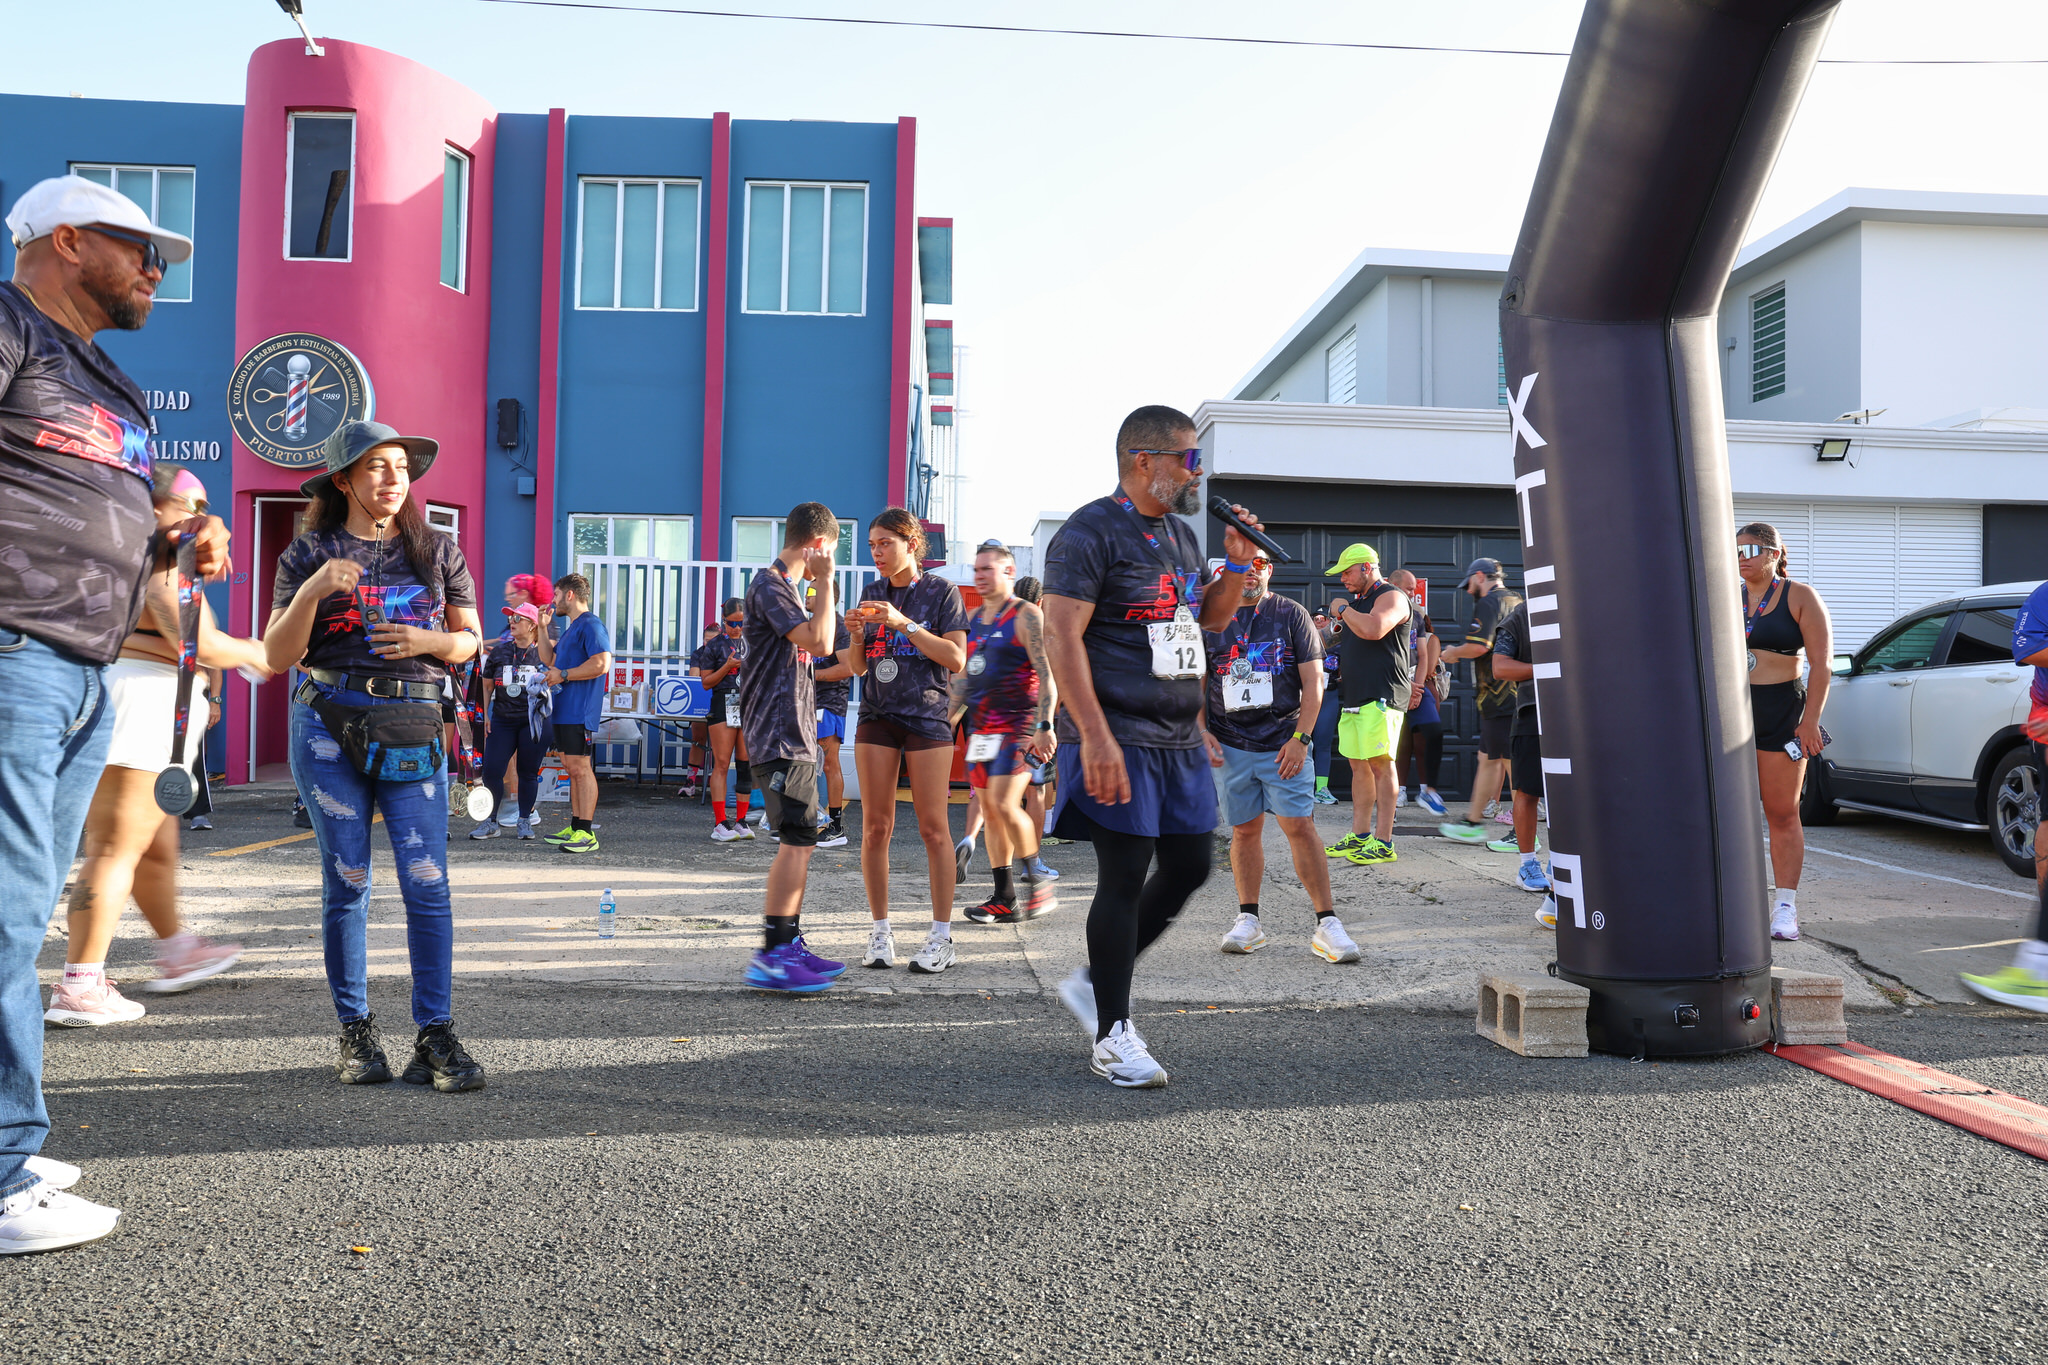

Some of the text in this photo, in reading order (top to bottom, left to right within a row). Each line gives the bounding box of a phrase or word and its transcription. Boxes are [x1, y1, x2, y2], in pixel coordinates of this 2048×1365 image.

[233, 370, 248, 405] COLEGIO
[245, 358, 256, 371] DE
[253, 339, 293, 362] BARBEROS
[300, 339, 339, 360] ESTILISTAS
[337, 358, 348, 368] EN
[345, 368, 360, 406] BARBERÍA
[142, 390, 190, 410] NDAD
[151, 440, 221, 461] ALISMO
[248, 436, 326, 462] PUERTO RIC
[234, 573, 248, 583] 29
[1125, 607, 1176, 620] FADE
[1174, 624, 1192, 633] FADE
[1185, 633, 1198, 641] RUN
[1175, 647, 1197, 669] 12
[1241, 688, 1251, 703] 4
